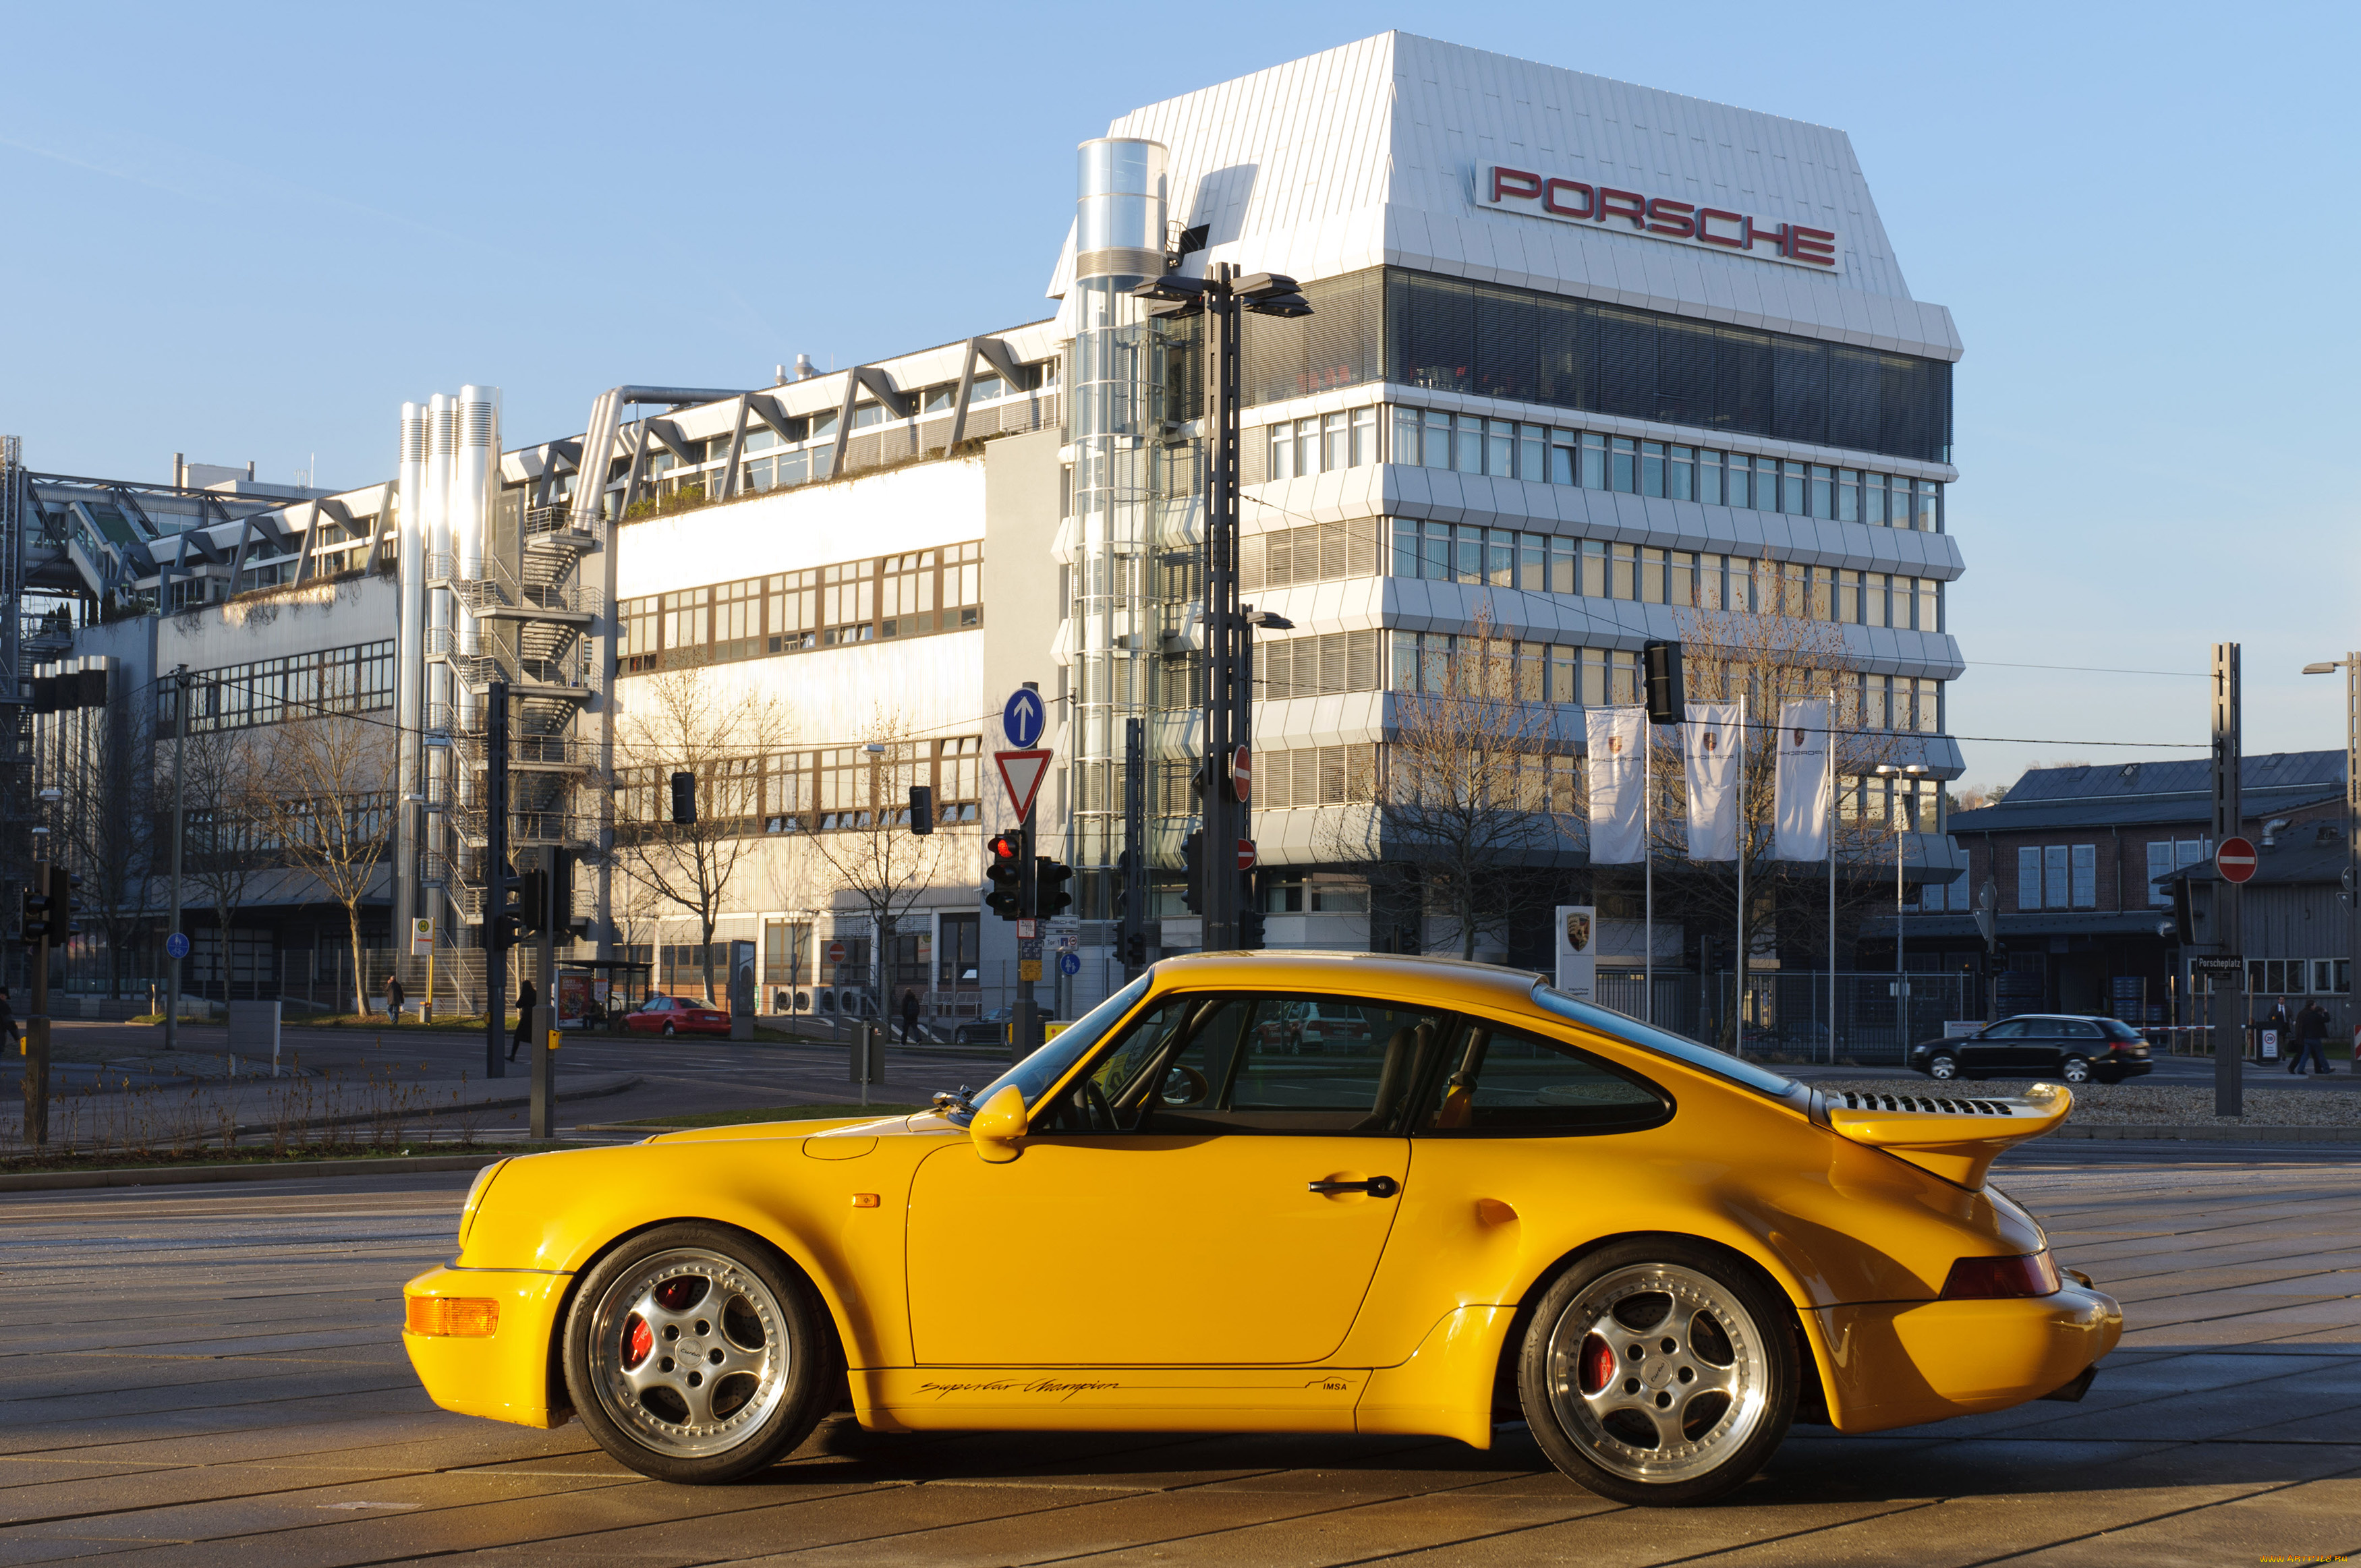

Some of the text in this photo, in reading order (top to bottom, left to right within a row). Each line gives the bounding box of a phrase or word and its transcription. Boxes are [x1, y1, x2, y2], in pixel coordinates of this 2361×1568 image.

[1491, 166, 1836, 266] PORSCHE
[2199, 958, 2241, 969] Porscheplatz
[680, 1348, 702, 1358] turbo
[1651, 1362, 1666, 1383] turbo
[1323, 1382, 1347, 1391] IMSA
